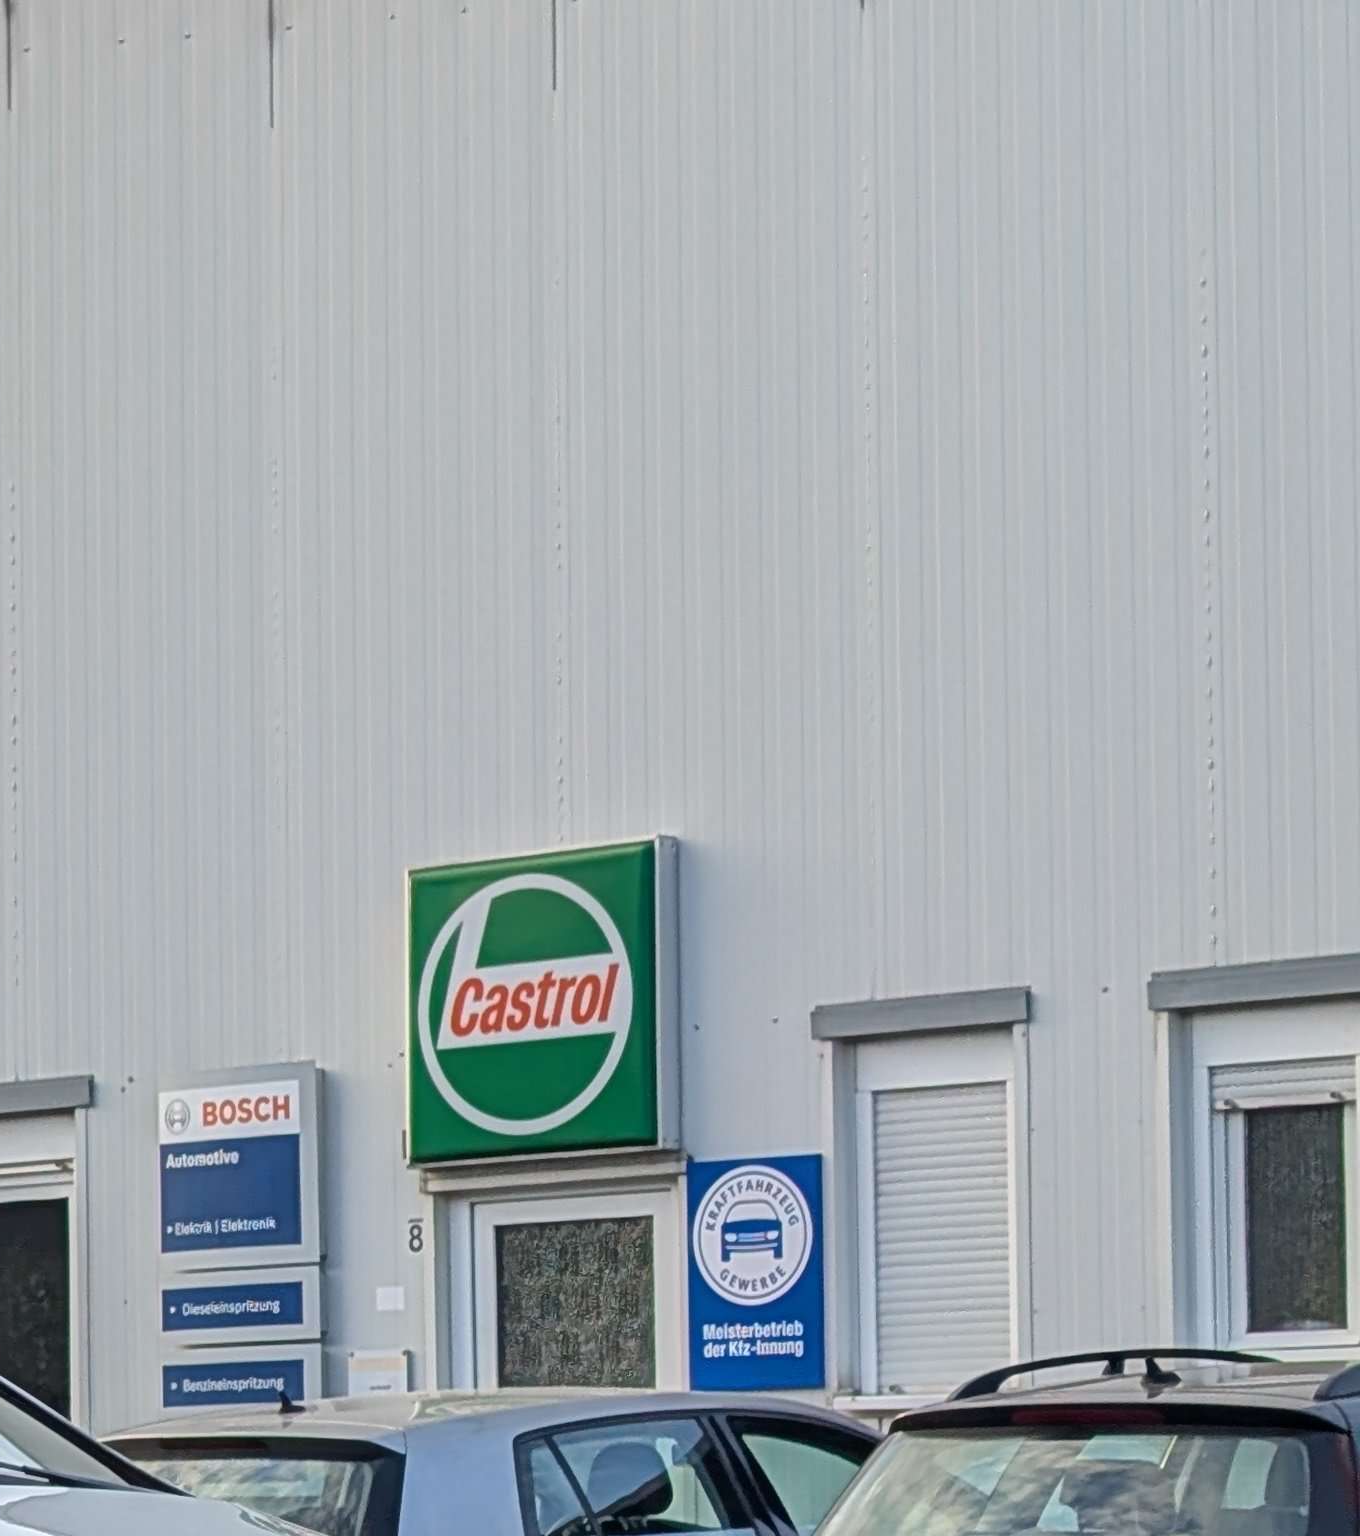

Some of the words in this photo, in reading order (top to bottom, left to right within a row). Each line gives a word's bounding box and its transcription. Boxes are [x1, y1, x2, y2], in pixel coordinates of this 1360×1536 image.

[449, 963, 620, 1038] Castrol
[201, 1094, 291, 1127] BOSCH
[166, 1149, 240, 1169] Automotive
[705, 1179, 800, 1231] KRAFTFAHRZEUG
[220, 1216, 277, 1233] Elektronik
[408, 1224, 424, 1252] 8
[719, 1266, 786, 1293] GEWERBE
[182, 1299, 281, 1317] Dieseleinspritzung
[702, 1320, 804, 1341] Meisterbetrieb
[703, 1342, 725, 1359] der
[728, 1338, 804, 1358] Kfz-Innung
[182, 1376, 285, 1393] Benzineinspritzung
